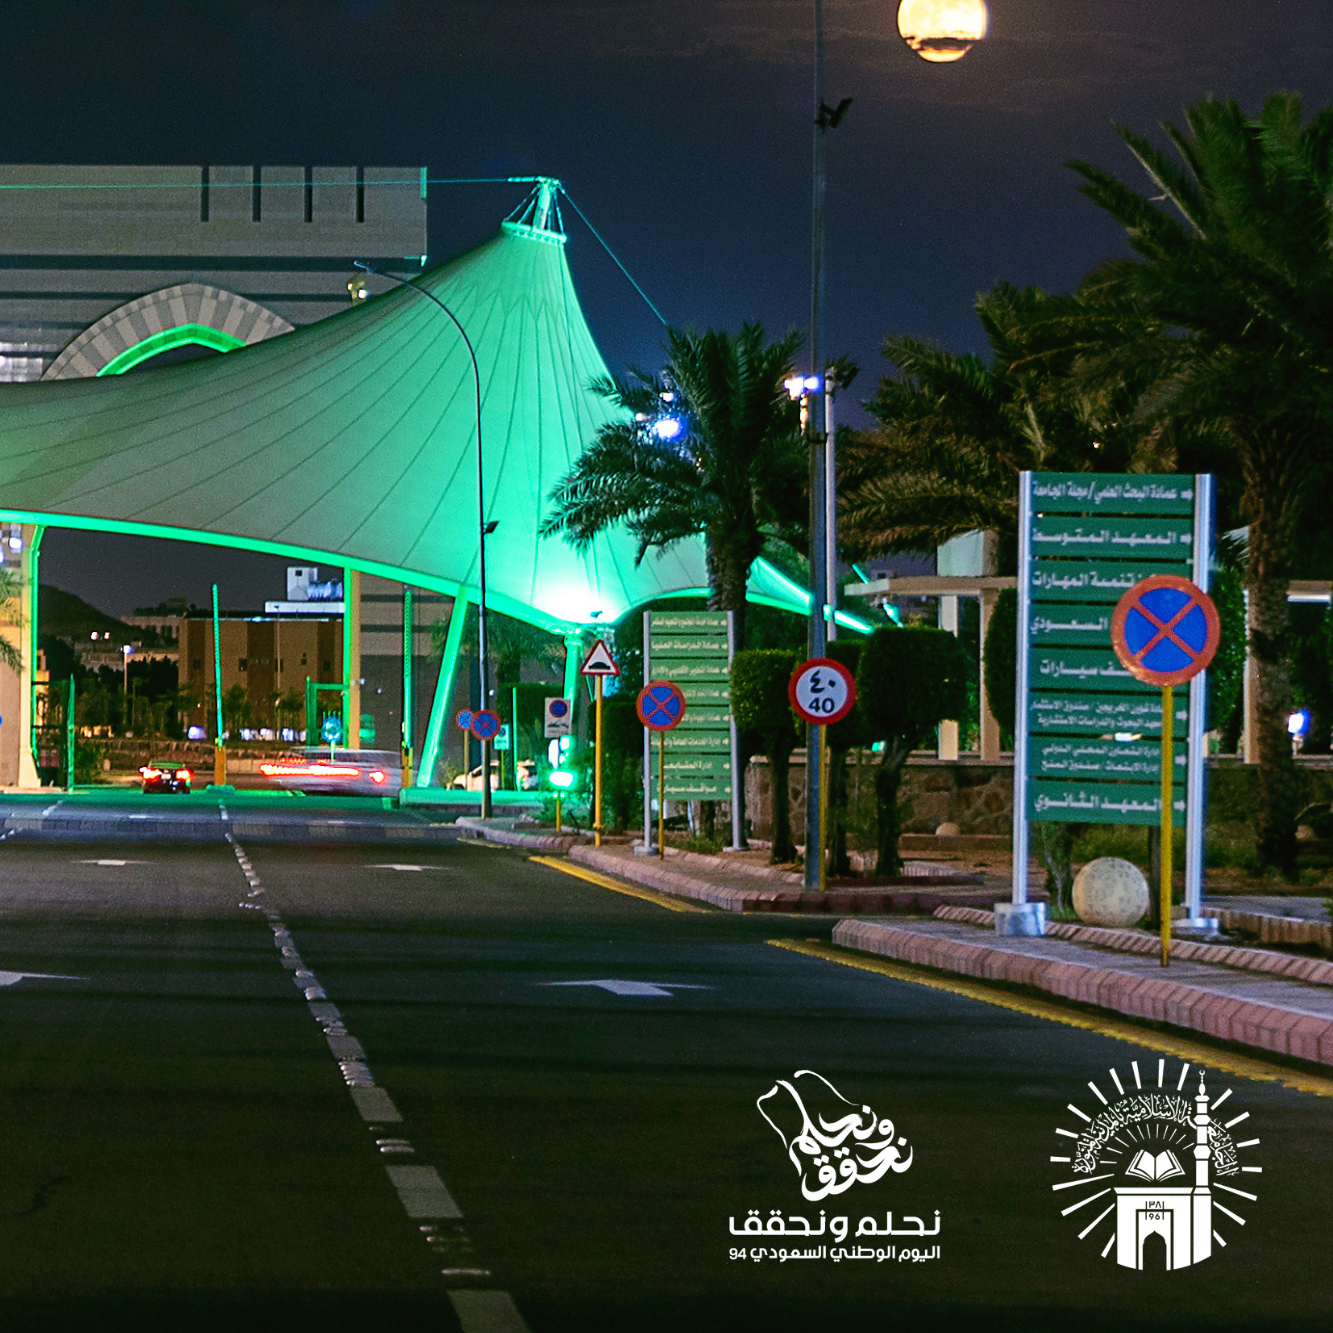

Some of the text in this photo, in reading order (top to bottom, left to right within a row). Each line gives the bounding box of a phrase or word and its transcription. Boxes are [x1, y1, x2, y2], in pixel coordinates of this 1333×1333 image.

[1123, 482, 1150, 502] البحث
[1150, 484, 1177, 499] عمادة
[1111, 530, 1177, 547] المعهد
[1032, 570, 1089, 589] المهارات
[1031, 616, 1108, 634] السعودي
[1039, 659, 1098, 678] سيارات
[808, 697, 835, 713] 40
[1034, 791, 1100, 812] الثانوي
